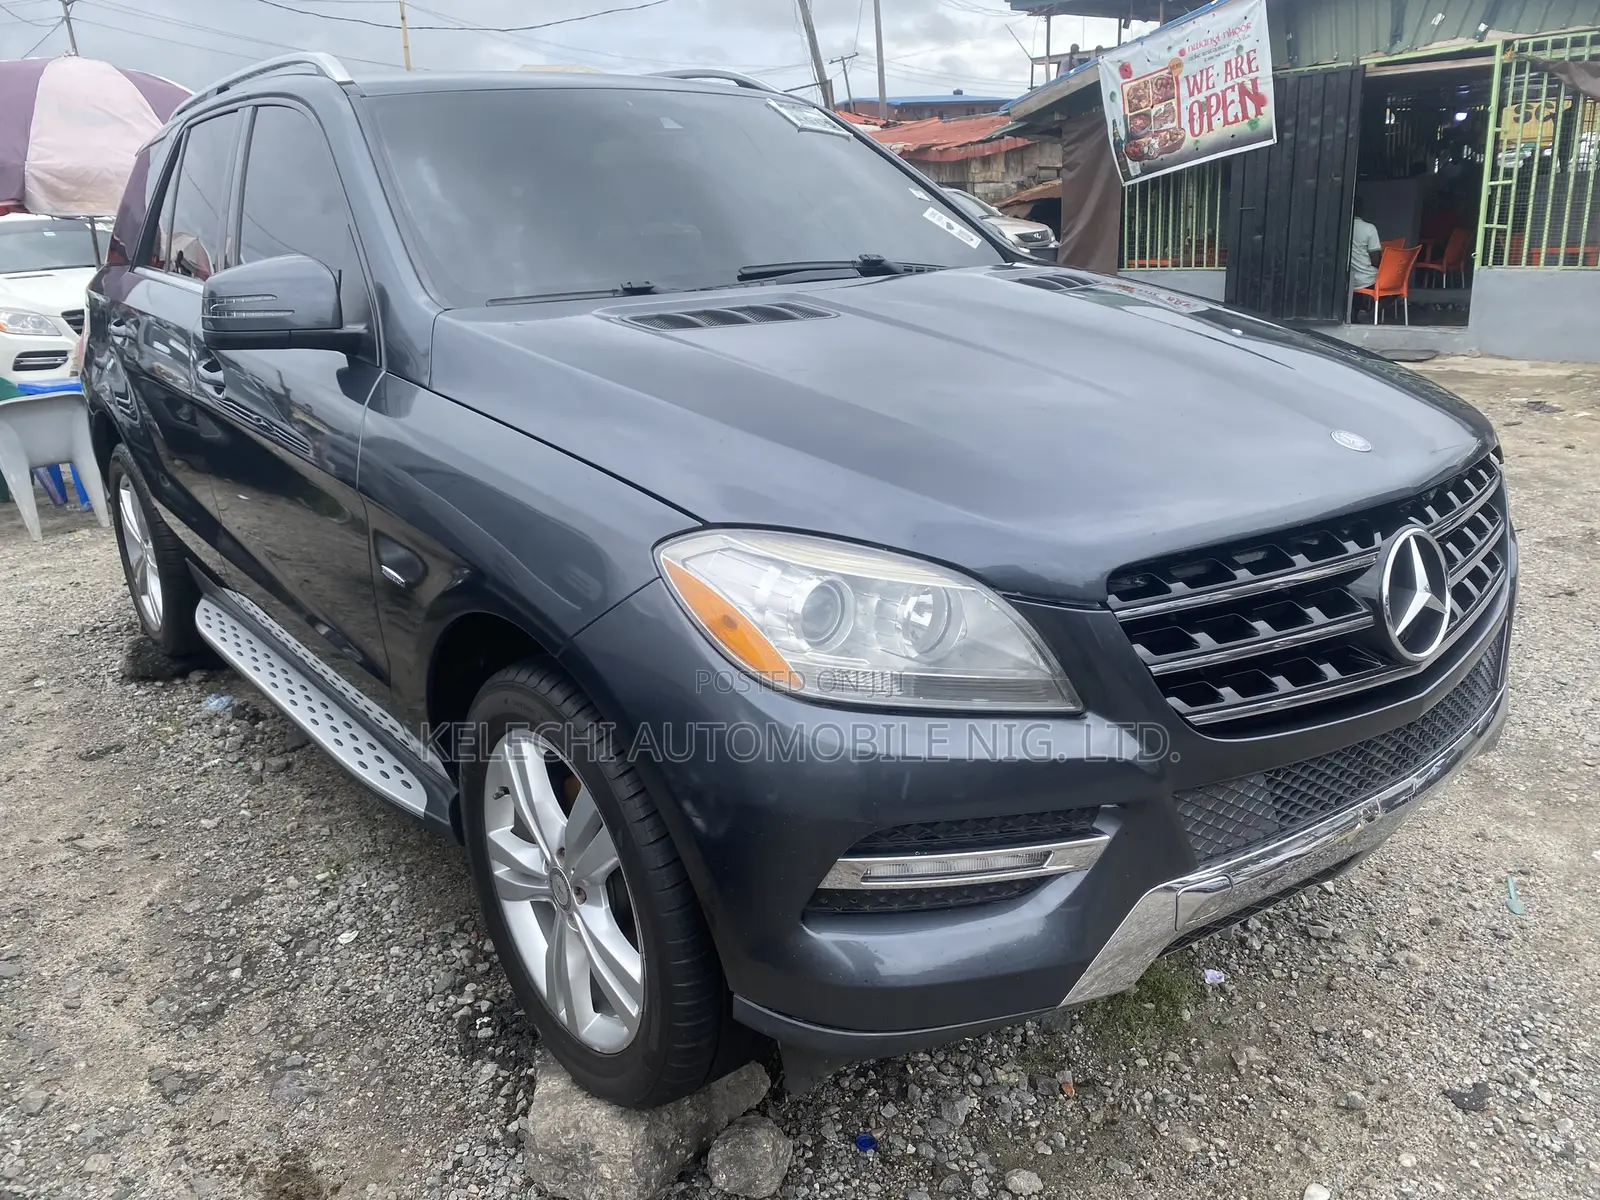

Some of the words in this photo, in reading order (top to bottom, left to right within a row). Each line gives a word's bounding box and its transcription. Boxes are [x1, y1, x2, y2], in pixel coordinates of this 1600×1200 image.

[1184, 65, 1216, 98] WE
[1224, 48, 1259, 82] ARE
[1188, 77, 1263, 138] OPEN
